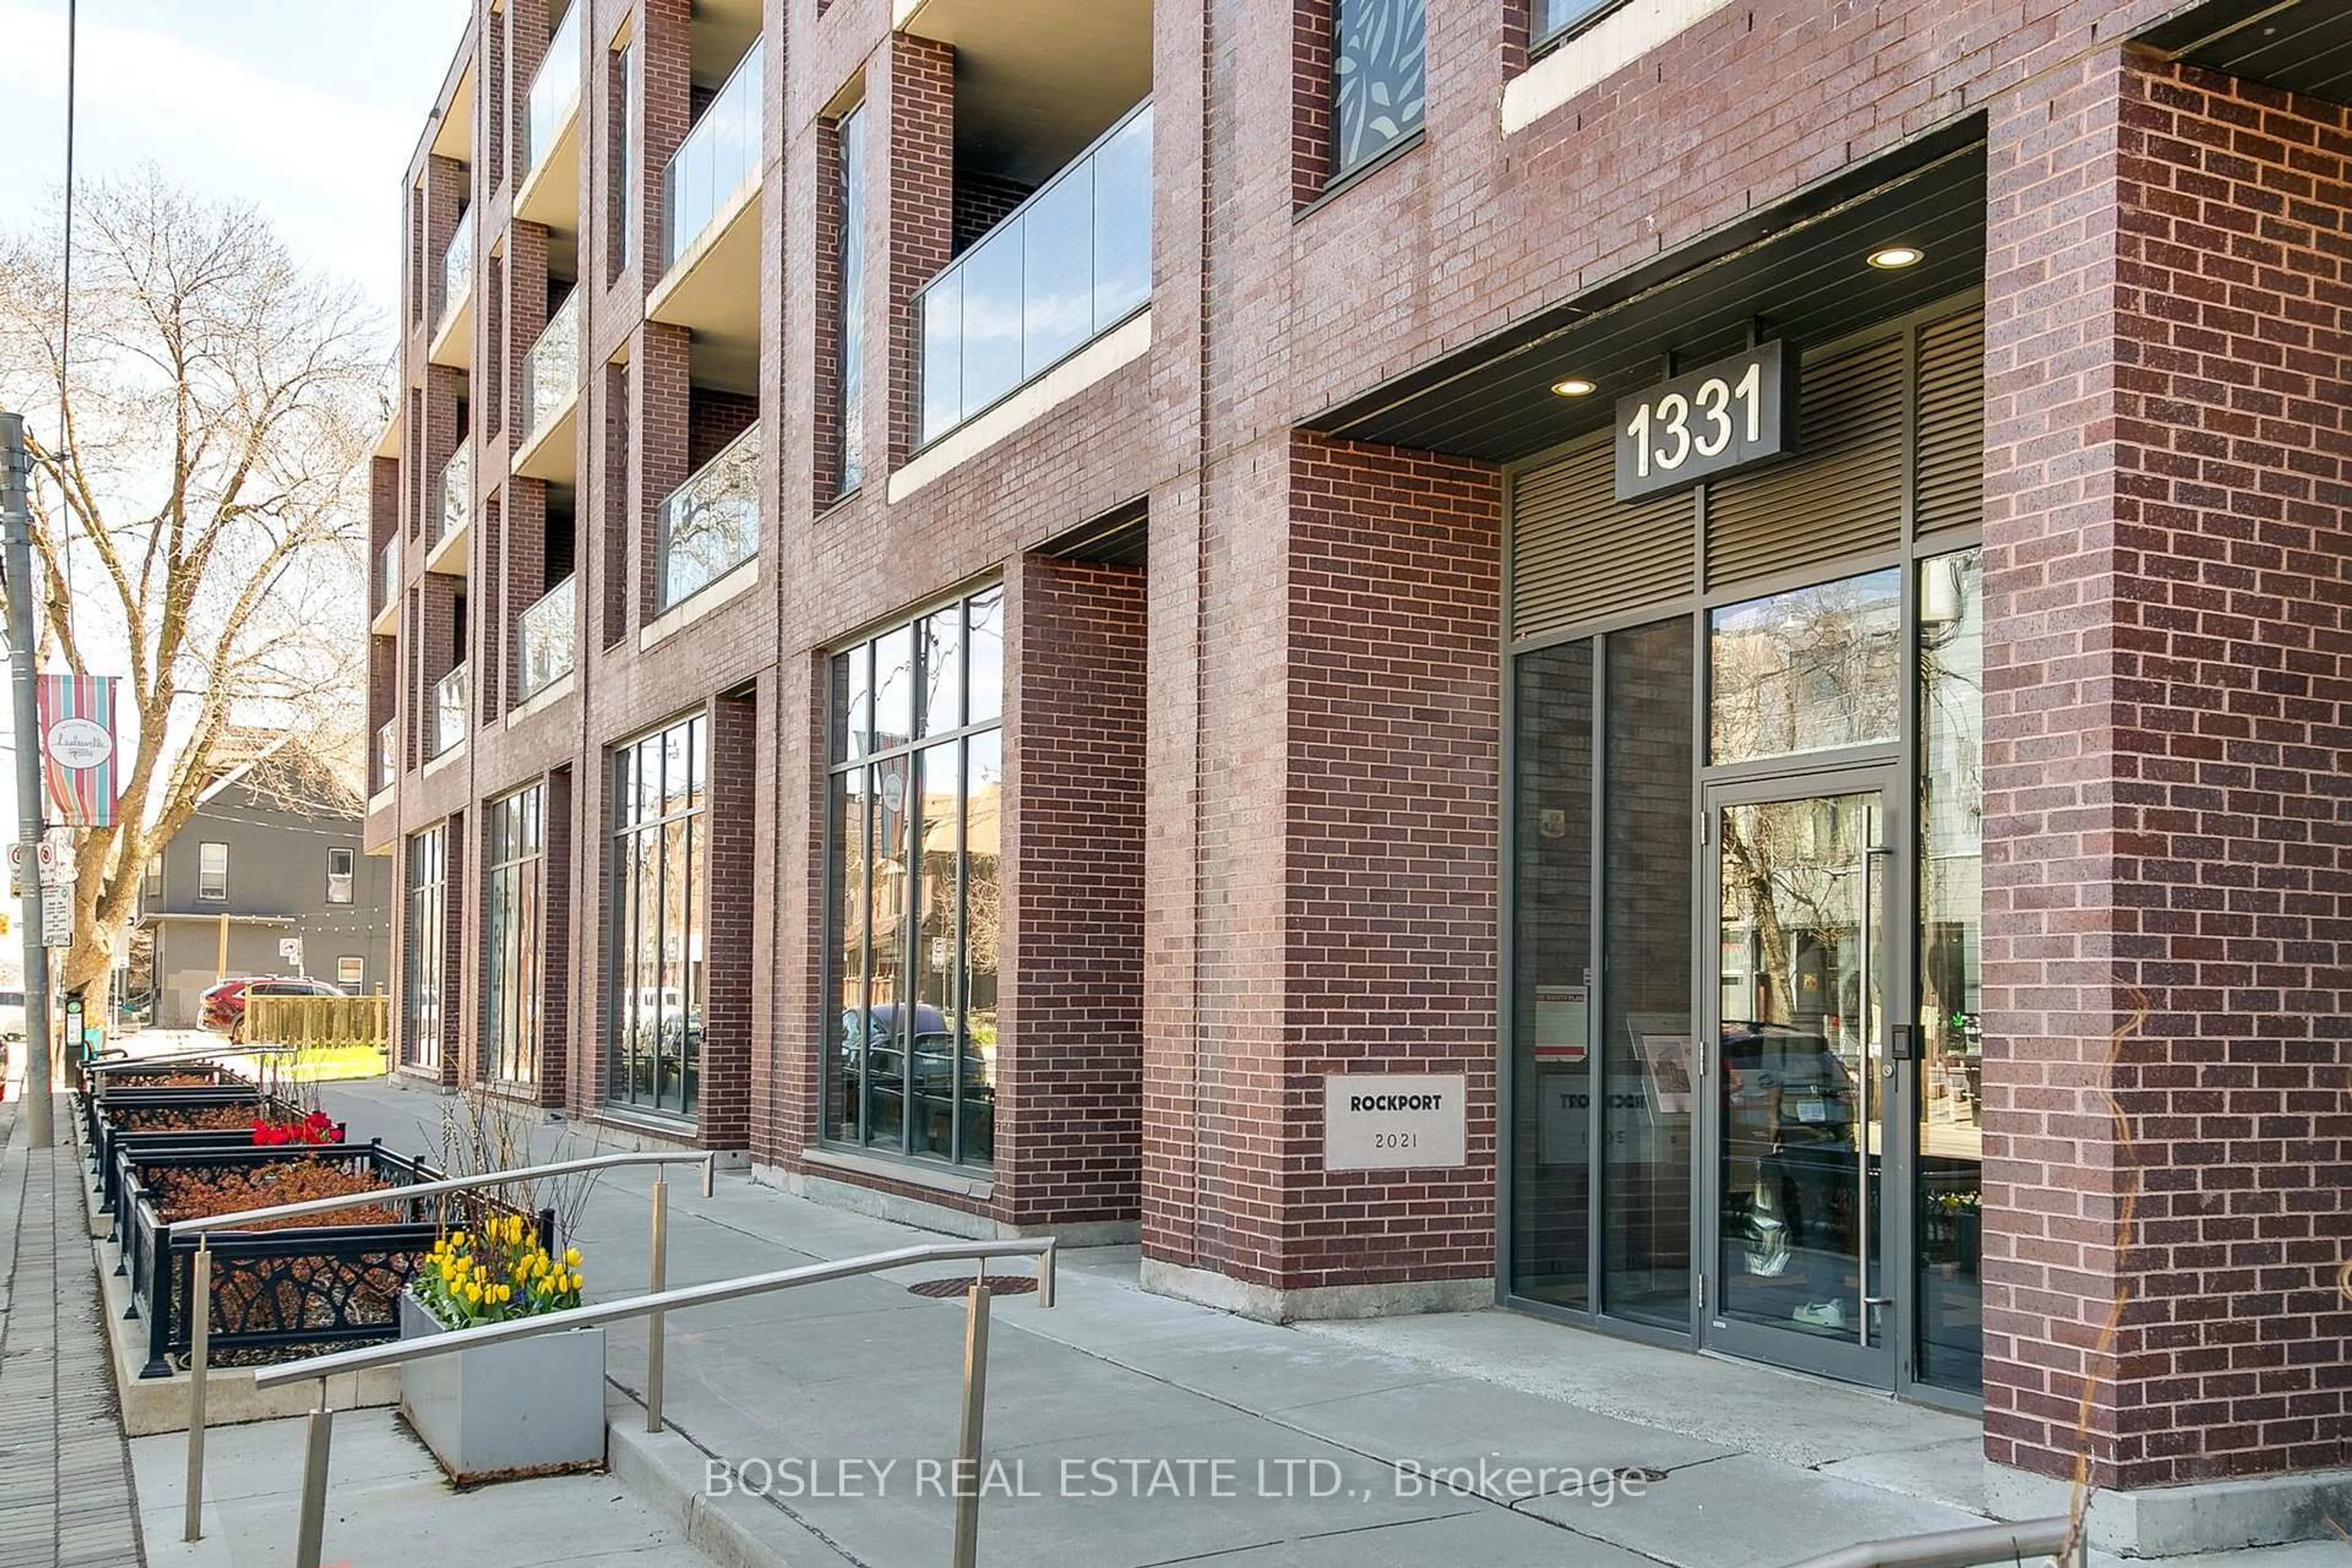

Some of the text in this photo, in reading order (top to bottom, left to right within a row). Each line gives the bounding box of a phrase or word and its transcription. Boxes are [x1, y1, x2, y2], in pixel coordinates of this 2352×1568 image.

[1627, 363, 1760, 478] 1331
[1351, 1094, 1442, 1112] ROCKPORT
[1375, 1133, 1417, 1148] 2021
